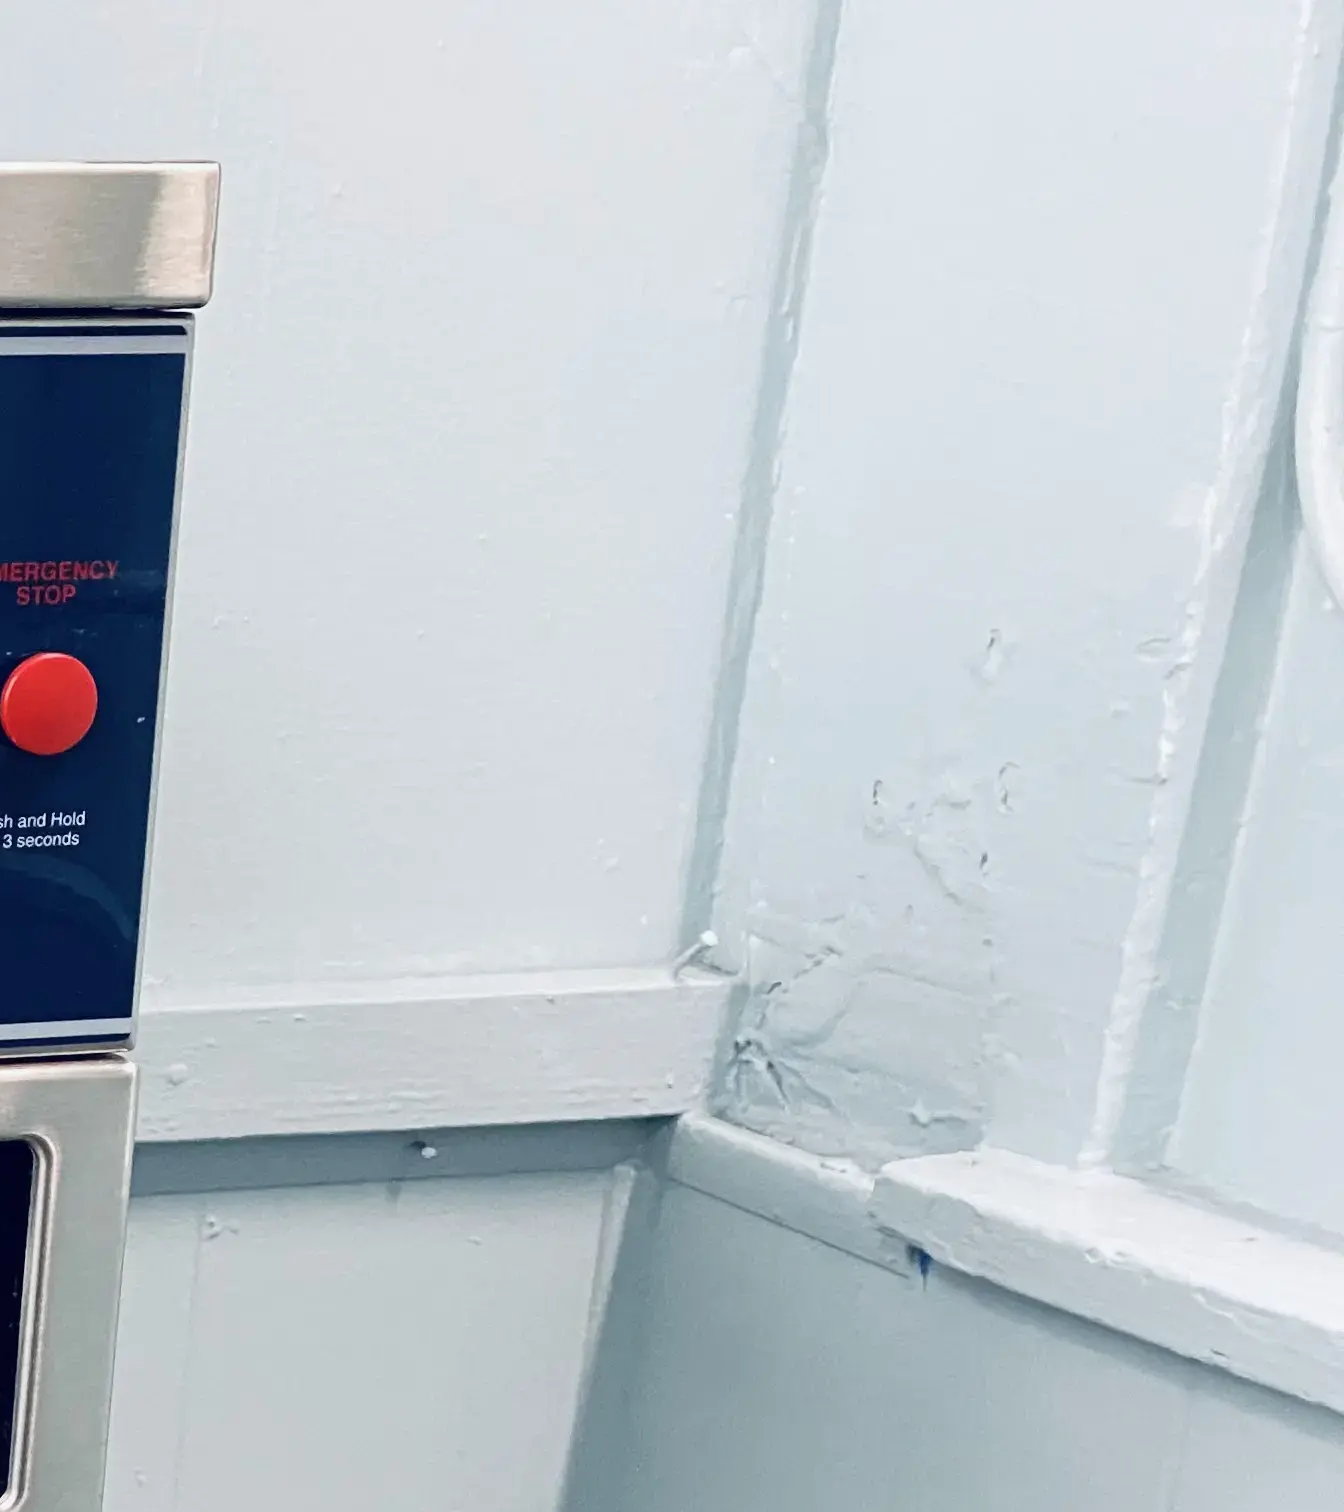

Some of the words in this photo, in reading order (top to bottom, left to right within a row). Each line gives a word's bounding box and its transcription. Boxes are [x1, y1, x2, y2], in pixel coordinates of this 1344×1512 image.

[16, 584, 76, 605] STOP
[17, 812, 47, 828] and
[50, 810, 86, 827] Hold
[2, 833, 13, 849] 3
[16, 831, 80, 848] seconds
